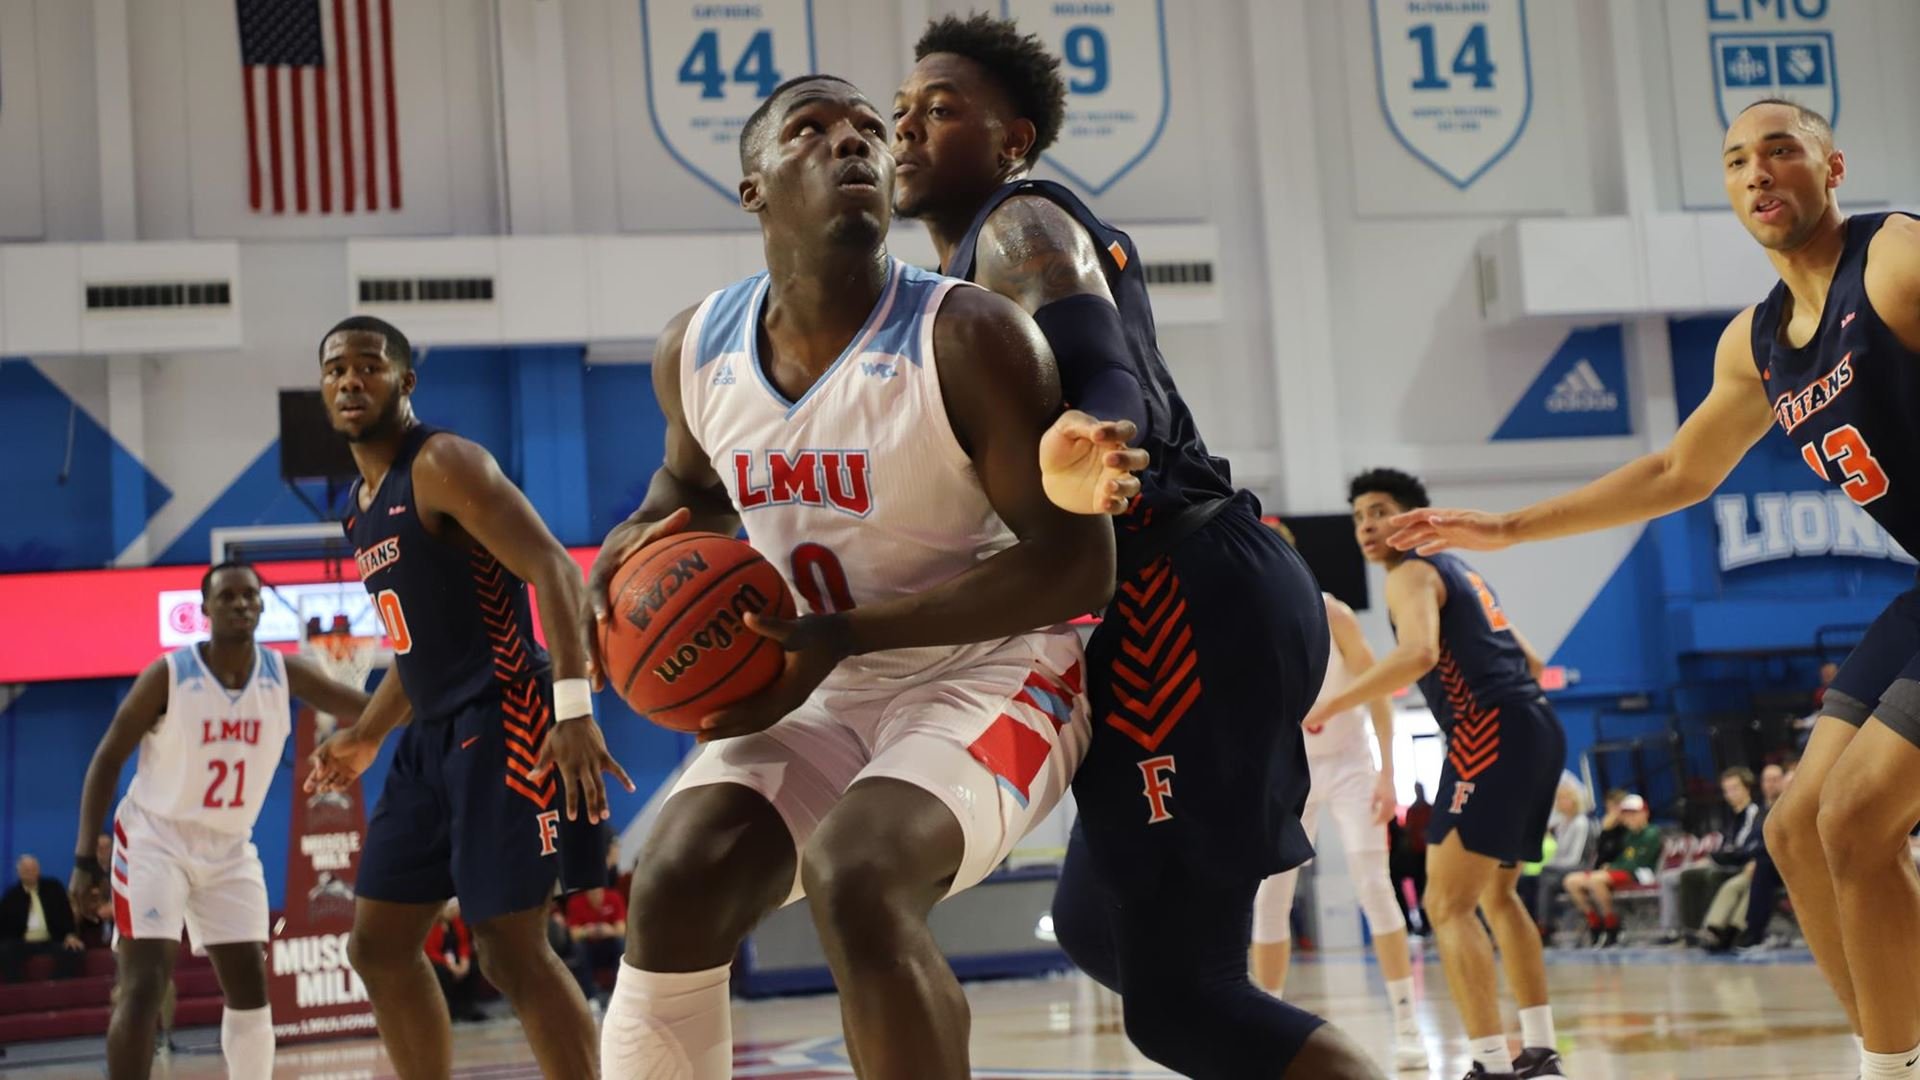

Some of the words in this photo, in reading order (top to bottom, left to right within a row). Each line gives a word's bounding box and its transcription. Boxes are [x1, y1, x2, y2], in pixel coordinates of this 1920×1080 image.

[677, 28, 783, 99] 44
[1064, 25, 1110, 95] 9
[1408, 23, 1497, 89] 14
[732, 449, 874, 519] LMU
[1715, 490, 1919, 571] LION
[627, 551, 710, 632] NCAA
[652, 583, 770, 684] Wilson
[202, 719, 262, 746] LMU
[203, 759, 246, 808] 21
[1137, 755, 1176, 825] F
[1449, 781, 1475, 814] F
[536, 809, 560, 857] F
